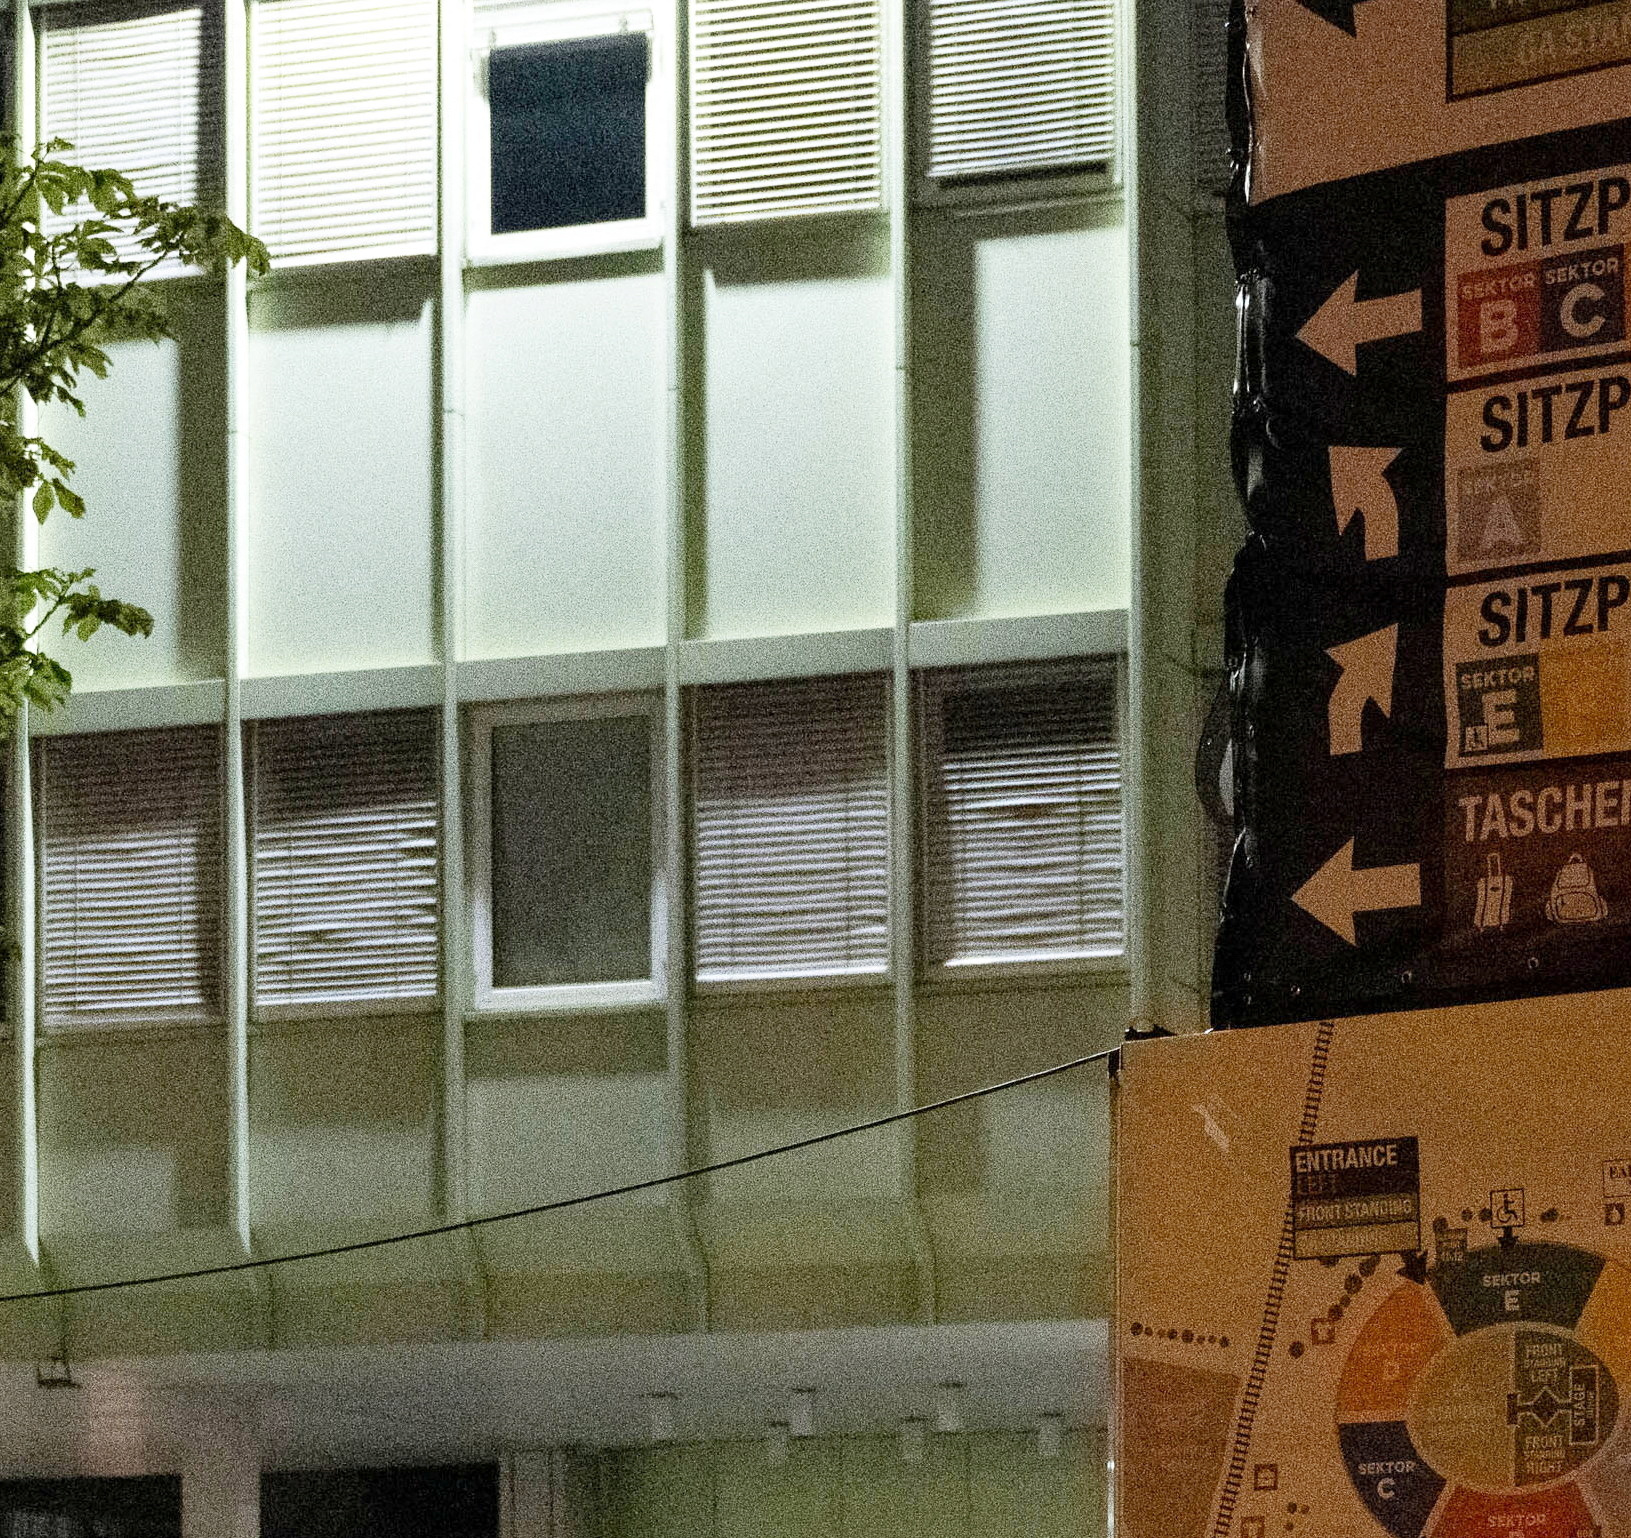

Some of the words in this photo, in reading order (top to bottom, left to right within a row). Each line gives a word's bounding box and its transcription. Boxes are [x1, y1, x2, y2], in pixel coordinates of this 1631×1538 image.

[1545, 258, 1619, 285] SEKTOR
[1462, 273, 1536, 299] SEKTOR
[1560, 283, 1605, 338] C
[1480, 300, 1518, 353] B
[1481, 496, 1525, 550] A
[1461, 666, 1535, 690] SEKTOR
[1482, 688, 1521, 745] E
[1295, 1144, 1398, 1173] ENTRANCE
[1482, 1271, 1541, 1288] SEKTOR
[1504, 1289, 1520, 1311] E
[1573, 1384, 1586, 1427] STAGE
[1358, 1460, 1416, 1475] SEKTOR
[1377, 1477, 1395, 1499] C
